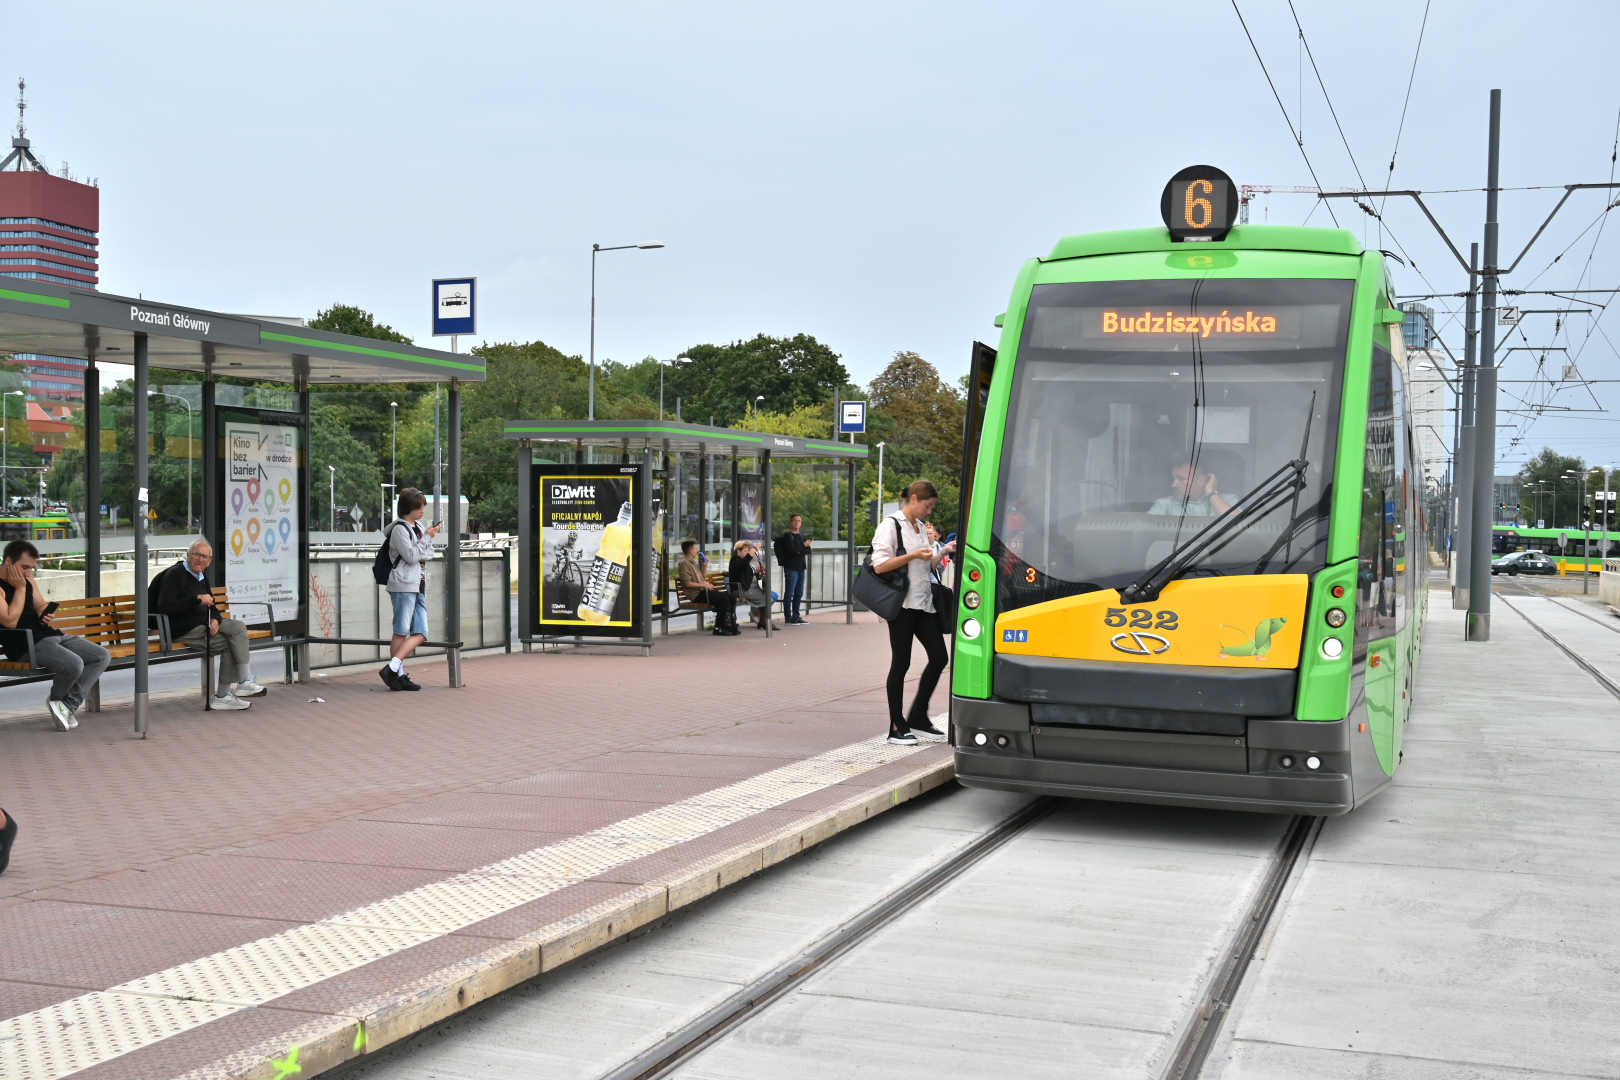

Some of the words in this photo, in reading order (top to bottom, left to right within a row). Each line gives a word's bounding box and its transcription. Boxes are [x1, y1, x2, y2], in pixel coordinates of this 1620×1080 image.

[1185, 179, 1213, 228] 6
[1502, 307, 1515, 320] Z
[130, 306, 170, 326] Poznań
[172, 313, 211, 335] Główny
[1102, 310, 1276, 338] Budziszyńska
[233, 437, 251, 449] Kino
[233, 451, 248, 462] bez
[271, 454, 292, 463] drodze
[233, 464, 257, 475] barier
[552, 485, 596, 499] DrWitt
[552, 512, 582, 521] OFICJALNY
[583, 511, 602, 521] NAPÓJ
[1025, 567, 1036, 583] 3
[1104, 607, 1179, 631] 522
